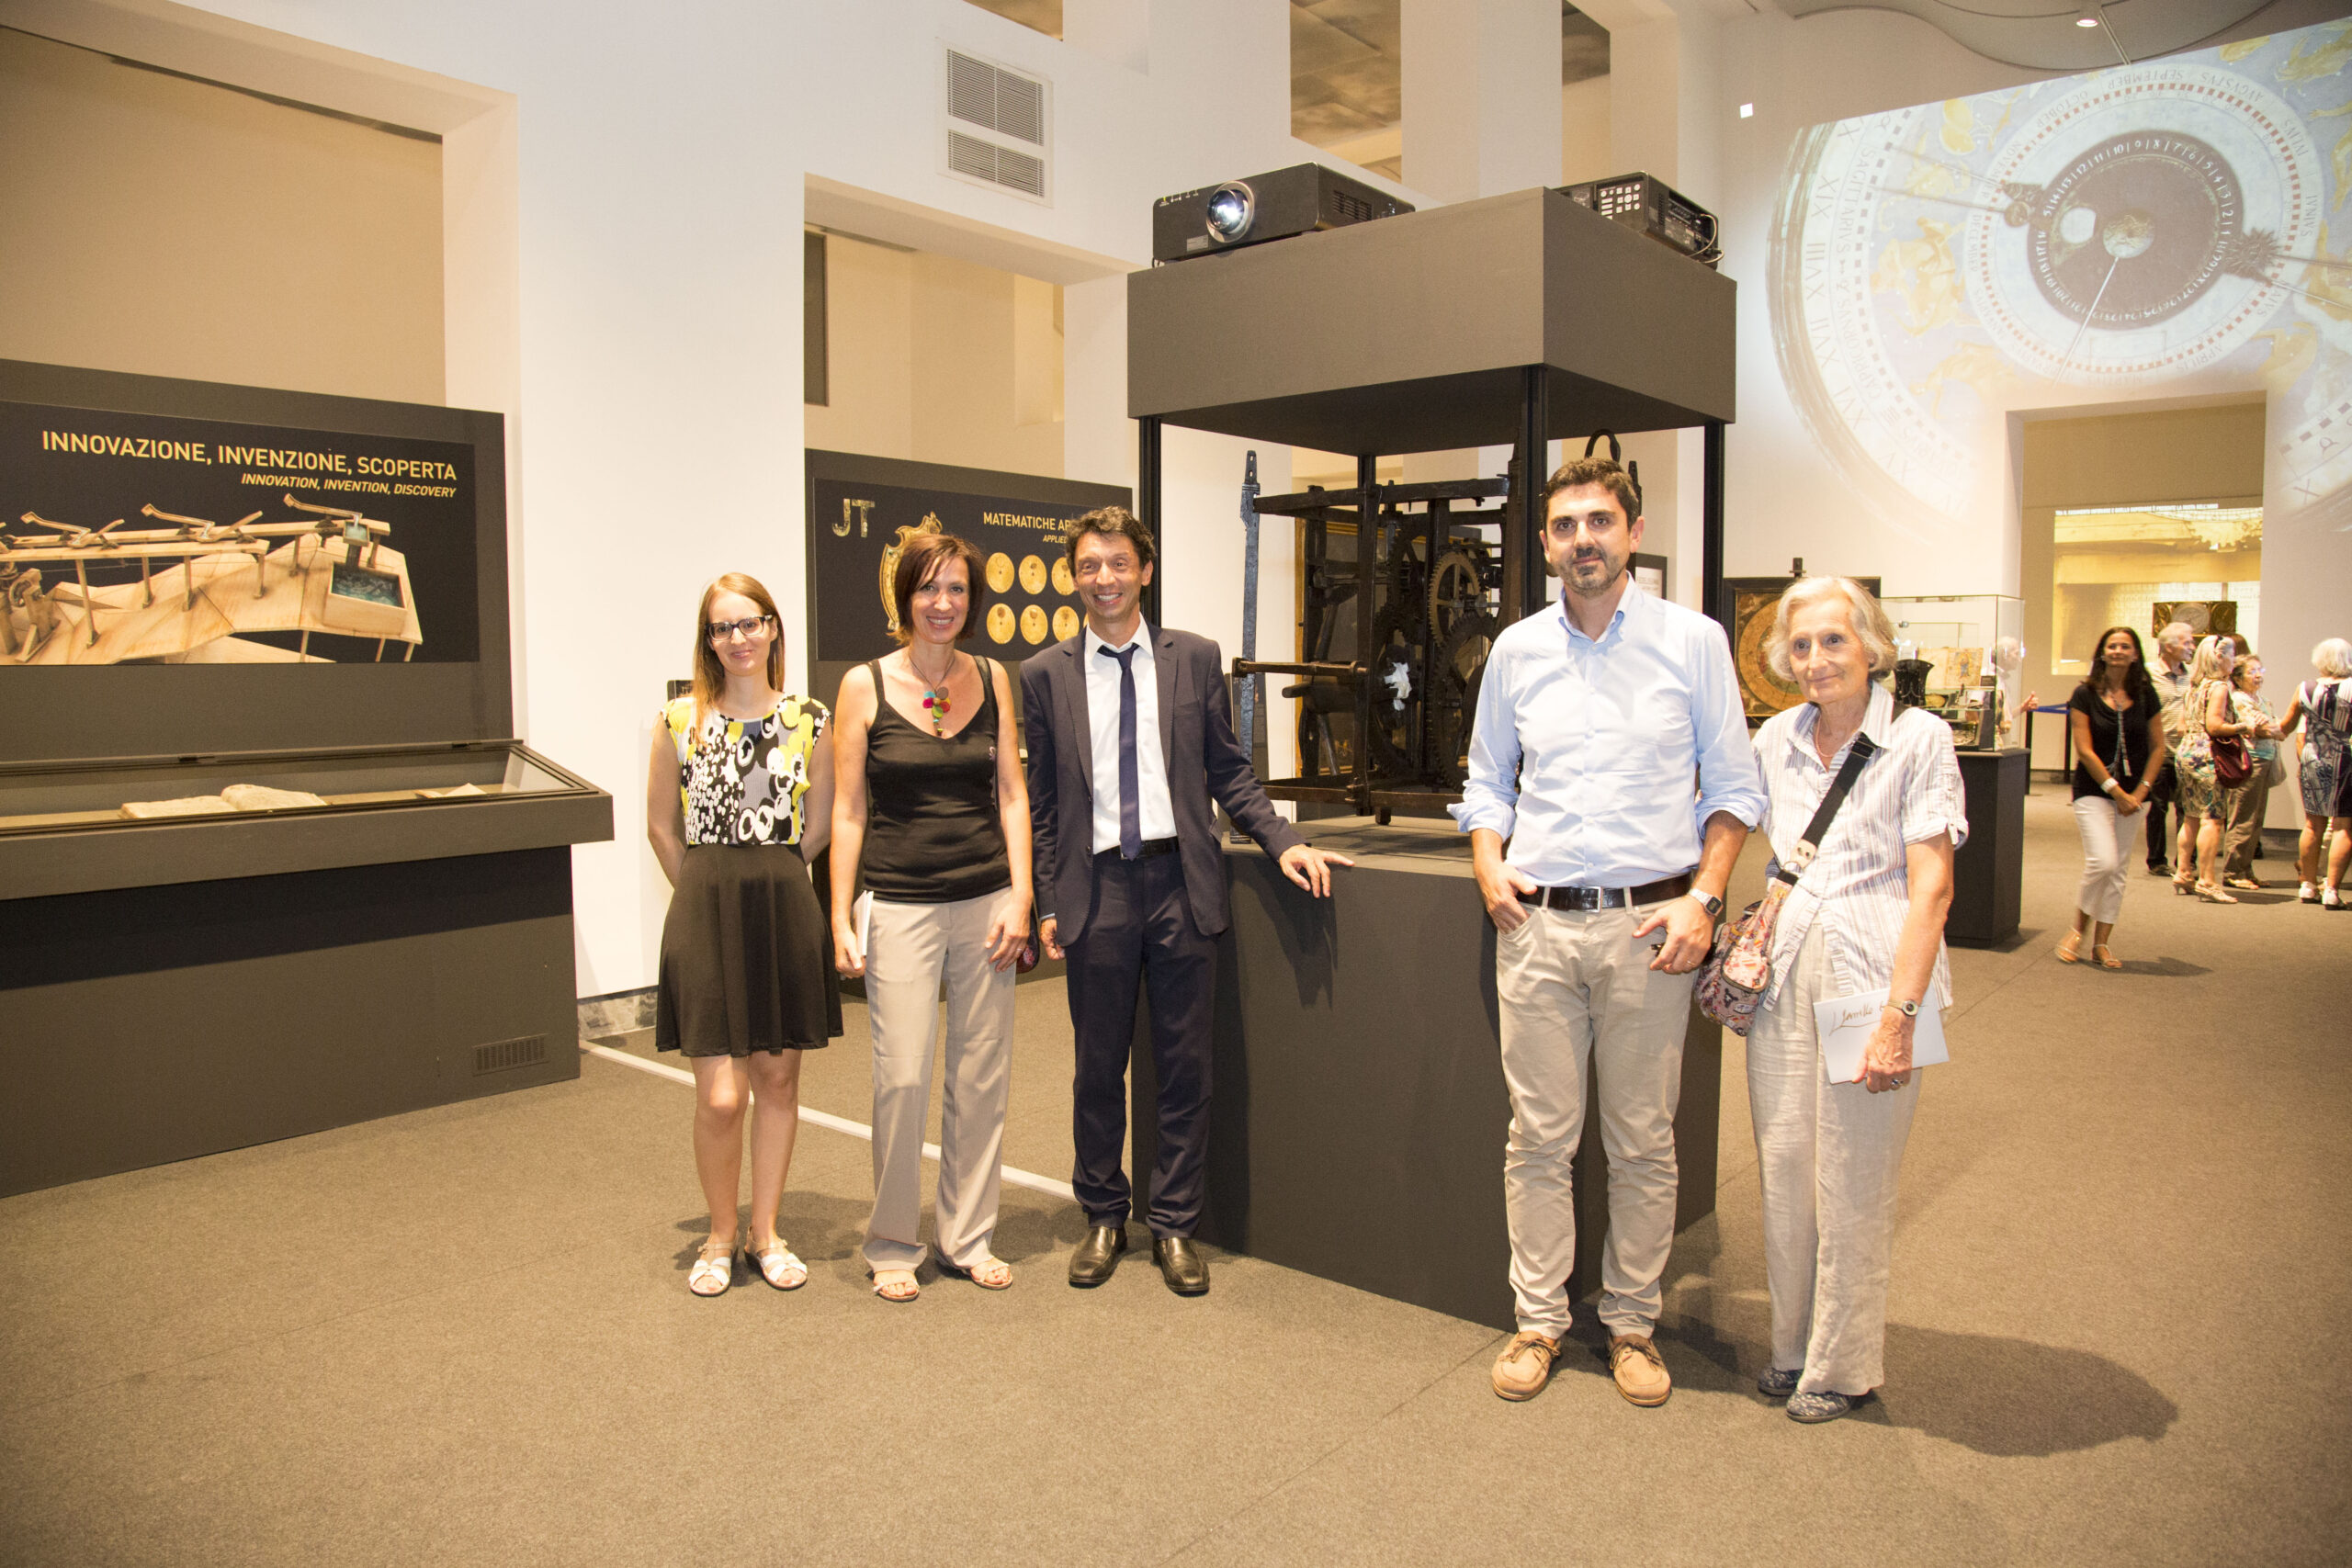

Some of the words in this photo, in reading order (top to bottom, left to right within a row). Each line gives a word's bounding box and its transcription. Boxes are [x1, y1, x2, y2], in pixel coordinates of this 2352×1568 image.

[2108, 69, 2184, 90] SEPTEMBER
[2035, 91, 2088, 129] OCTOBER
[2113, 143, 2123, 154] 10
[2134, 140, 2141, 148] 9
[2175, 142, 2182, 151] 7
[2094, 152, 2104, 163] 11
[2188, 150, 2196, 160] 6
[1981, 142, 2022, 199] NOVEMER
[2075, 164, 2088, 175] 12
[2204, 162, 2214, 170] 5
[1811, 175, 1839, 220] XIX
[2220, 191, 2233, 199] 3
[2222, 209, 2234, 218] 2
[42, 431, 212, 466] INNOVAZIONE,
[218, 445, 352, 476] INVENZIONE,
[356, 457, 458, 480] SCOPERTA
[241, 473, 321, 491] INNOVATION,
[323, 479, 391, 495] INVENTION,
[393, 483, 457, 498] DISCOVERY
[832, 498, 876, 538] JT
[983, 511, 1056, 531] MATEMATICHE
